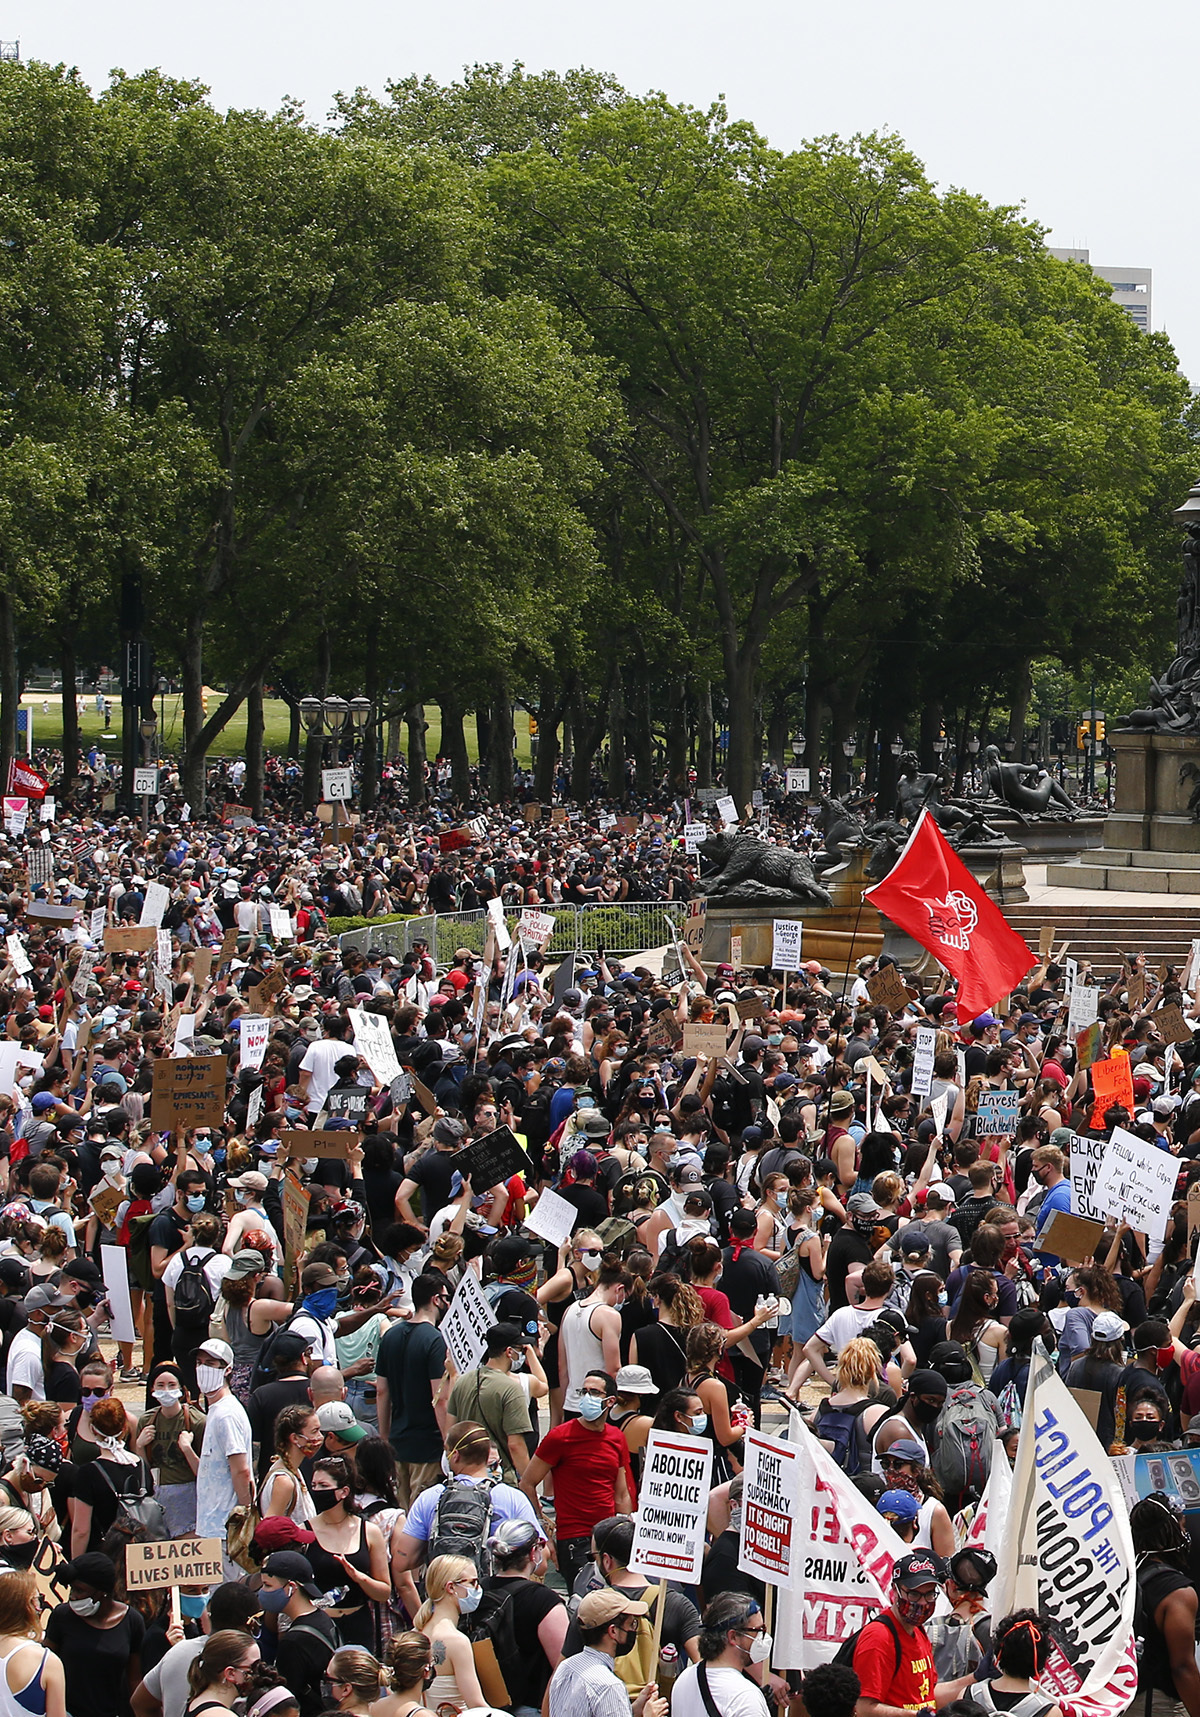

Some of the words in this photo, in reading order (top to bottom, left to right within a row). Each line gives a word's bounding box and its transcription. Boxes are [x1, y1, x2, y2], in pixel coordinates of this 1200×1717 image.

[136, 779, 155, 792] CD-1
[330, 783, 345, 796] C-1
[792, 778, 804, 790] D-1
[524, 911, 541, 920] END
[686, 902, 706, 918] BLM
[775, 922, 798, 932] Justice
[694, 1026, 713, 1037] Black
[1156, 1014, 1178, 1030] Defund
[248, 1036, 266, 1048] NOW
[919, 1034, 932, 1046] STOP
[174, 1091, 216, 1100] EPHESIANS
[980, 1093, 1018, 1108] Invest
[1070, 1136, 1106, 1160] BLACK
[1104, 1177, 1116, 1193] does
[1118, 1182, 1134, 1199] NOT
[1132, 1193, 1160, 1214] excuse
[466, 1278, 475, 1296] NO
[473, 1298, 492, 1328] MORE
[458, 1286, 487, 1346] Racist
[446, 1318, 468, 1374] Terror!
[452, 1310, 474, 1361] Police
[650, 1453, 705, 1481] ABOLISH
[758, 1451, 782, 1472] FIGHT
[756, 1468, 782, 1495] WHITE
[649, 1482, 663, 1497] THE
[663, 1482, 700, 1504] POLICE
[747, 1482, 791, 1514] SUPREMACY
[642, 1506, 698, 1530] COMMUNITY
[748, 1505, 756, 1522] IT
[756, 1508, 763, 1525] IS
[763, 1510, 790, 1536] RIGHT
[639, 1526, 666, 1542] CONTROL
[666, 1530, 686, 1545] NOW!
[745, 1524, 755, 1544] TO
[756, 1528, 781, 1554] REBEL!
[144, 1541, 202, 1560] BLACK
[130, 1567, 169, 1585] LIVES
[174, 1560, 224, 1580] MATTER
